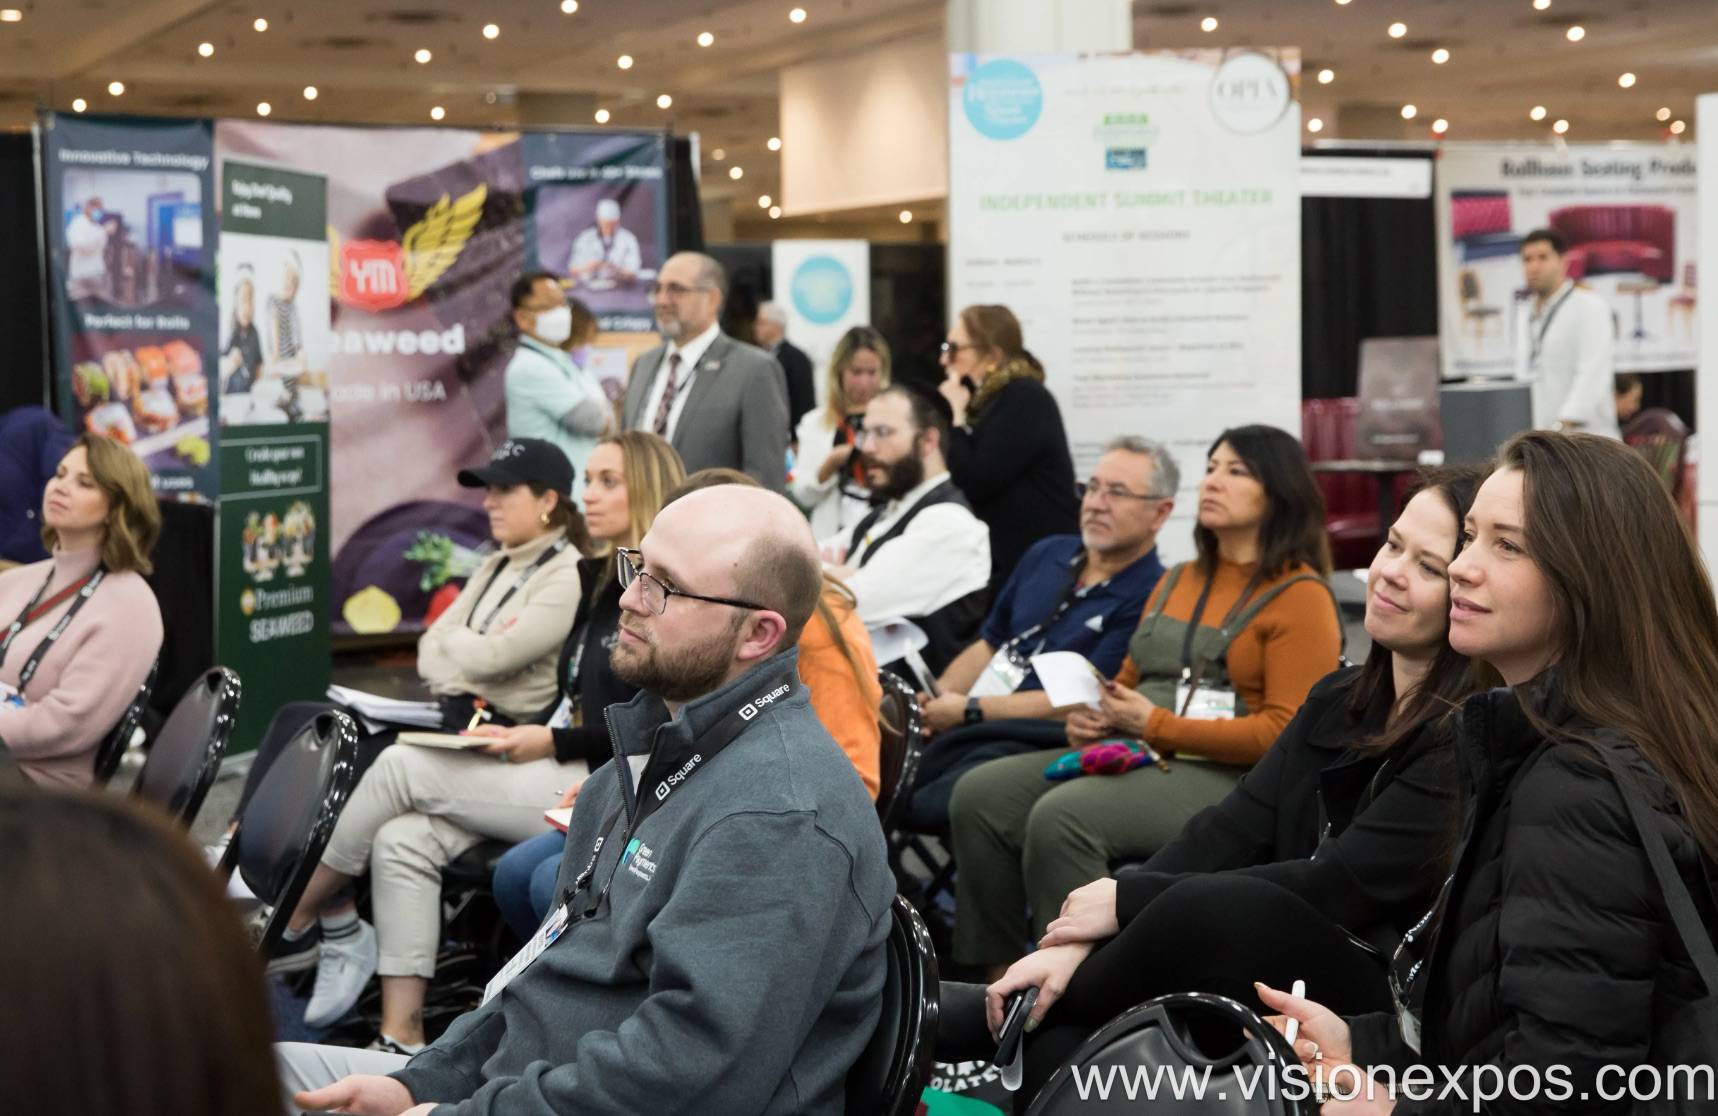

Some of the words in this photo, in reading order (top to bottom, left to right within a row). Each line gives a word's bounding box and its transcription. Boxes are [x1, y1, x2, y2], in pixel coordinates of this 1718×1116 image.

[57, 149, 131, 165] Innovative
[133, 150, 209, 171] Technology
[980, 191, 1106, 213] INDEPENDENT
[1116, 189, 1186, 210] SUMMIT
[1192, 187, 1274, 207] THEATER
[350, 258, 398, 295] YM
[84, 312, 133, 329] Perfect
[134, 313, 155, 330] for
[405, 380, 447, 400] USA
[256, 585, 314, 611] Premium
[248, 609, 315, 643] SEAWEED
[754, 683, 790, 709] Square
[666, 753, 702, 787] Square
